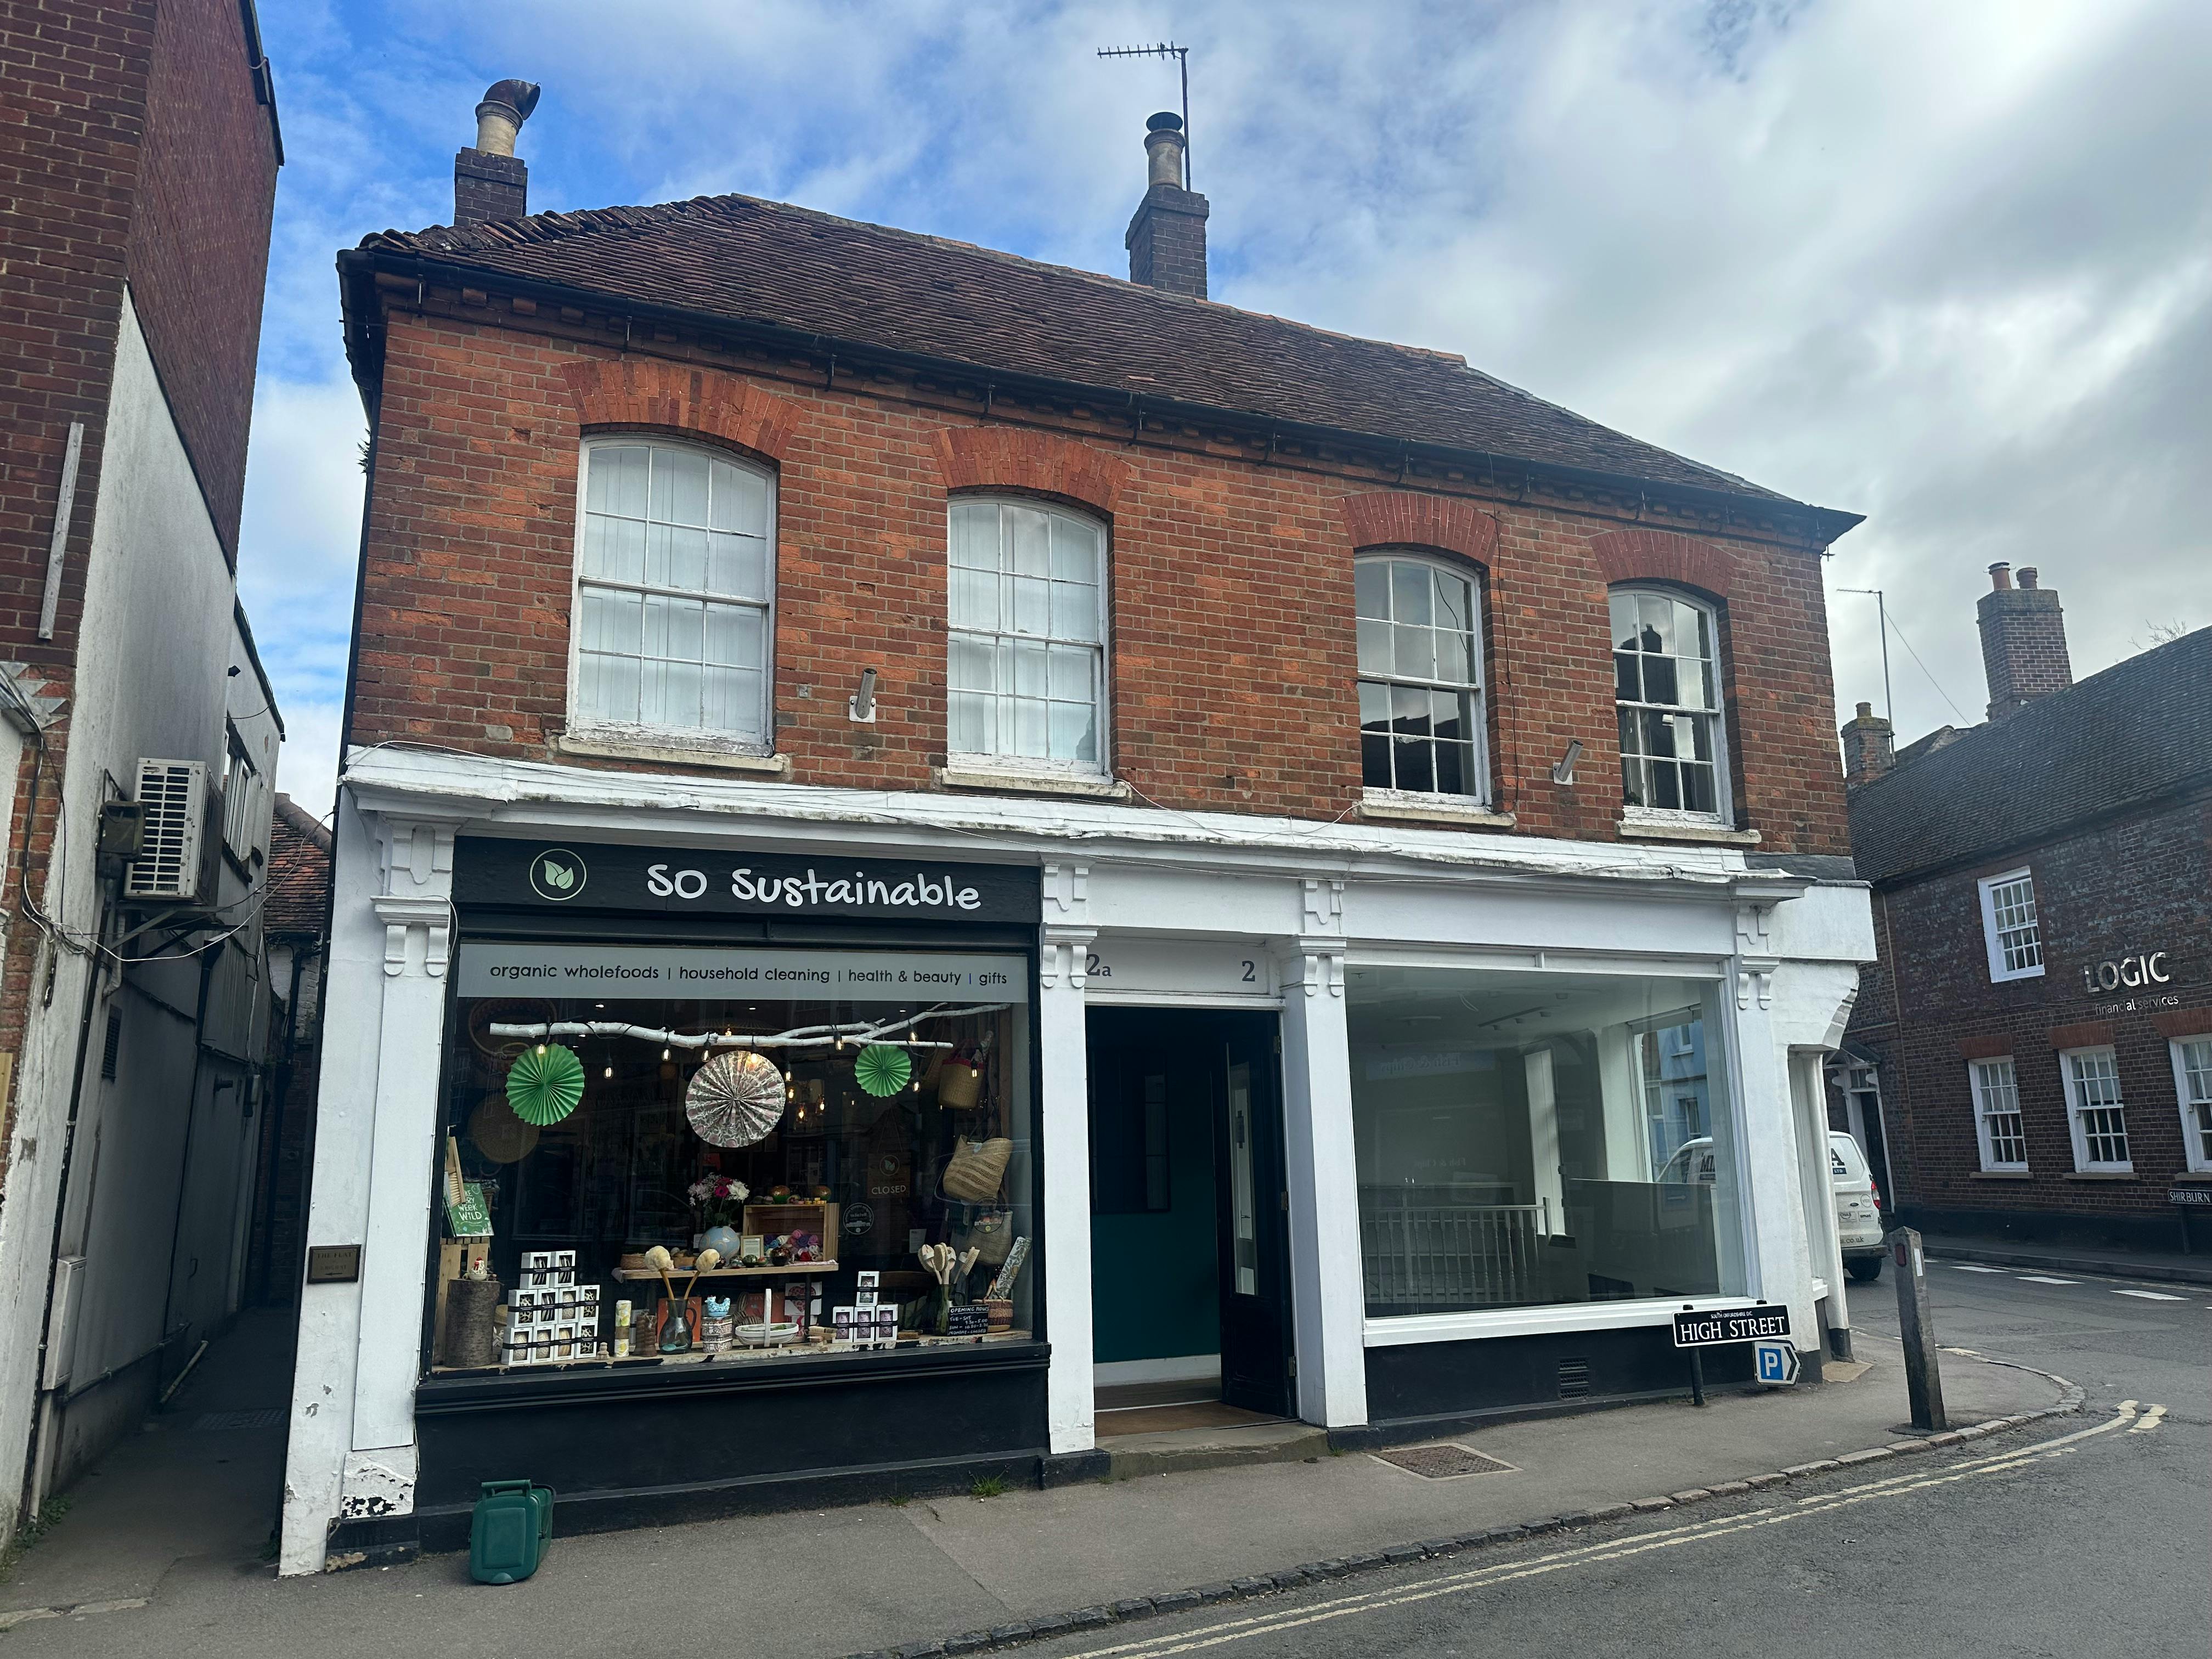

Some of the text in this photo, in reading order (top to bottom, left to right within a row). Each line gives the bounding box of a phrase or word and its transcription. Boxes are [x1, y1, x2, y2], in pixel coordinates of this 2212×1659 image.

[731, 868, 981, 910] Sustainable
[490, 964, 1007, 986] organic wholefoods household cleaning health & beauty gifts
[1086, 953, 1112, 977] 2a
[1242, 961, 1256, 982] 2
[2084, 952, 2170, 993] LOGIC
[2095, 995, 2179, 1015] financial services
[871, 1184, 906, 1195] CLOSED
[2169, 1191, 2211, 1203] SHIRBURN
[1680, 1316, 1785, 1341] HIGH STREET
[1764, 1352, 1778, 1376] P
